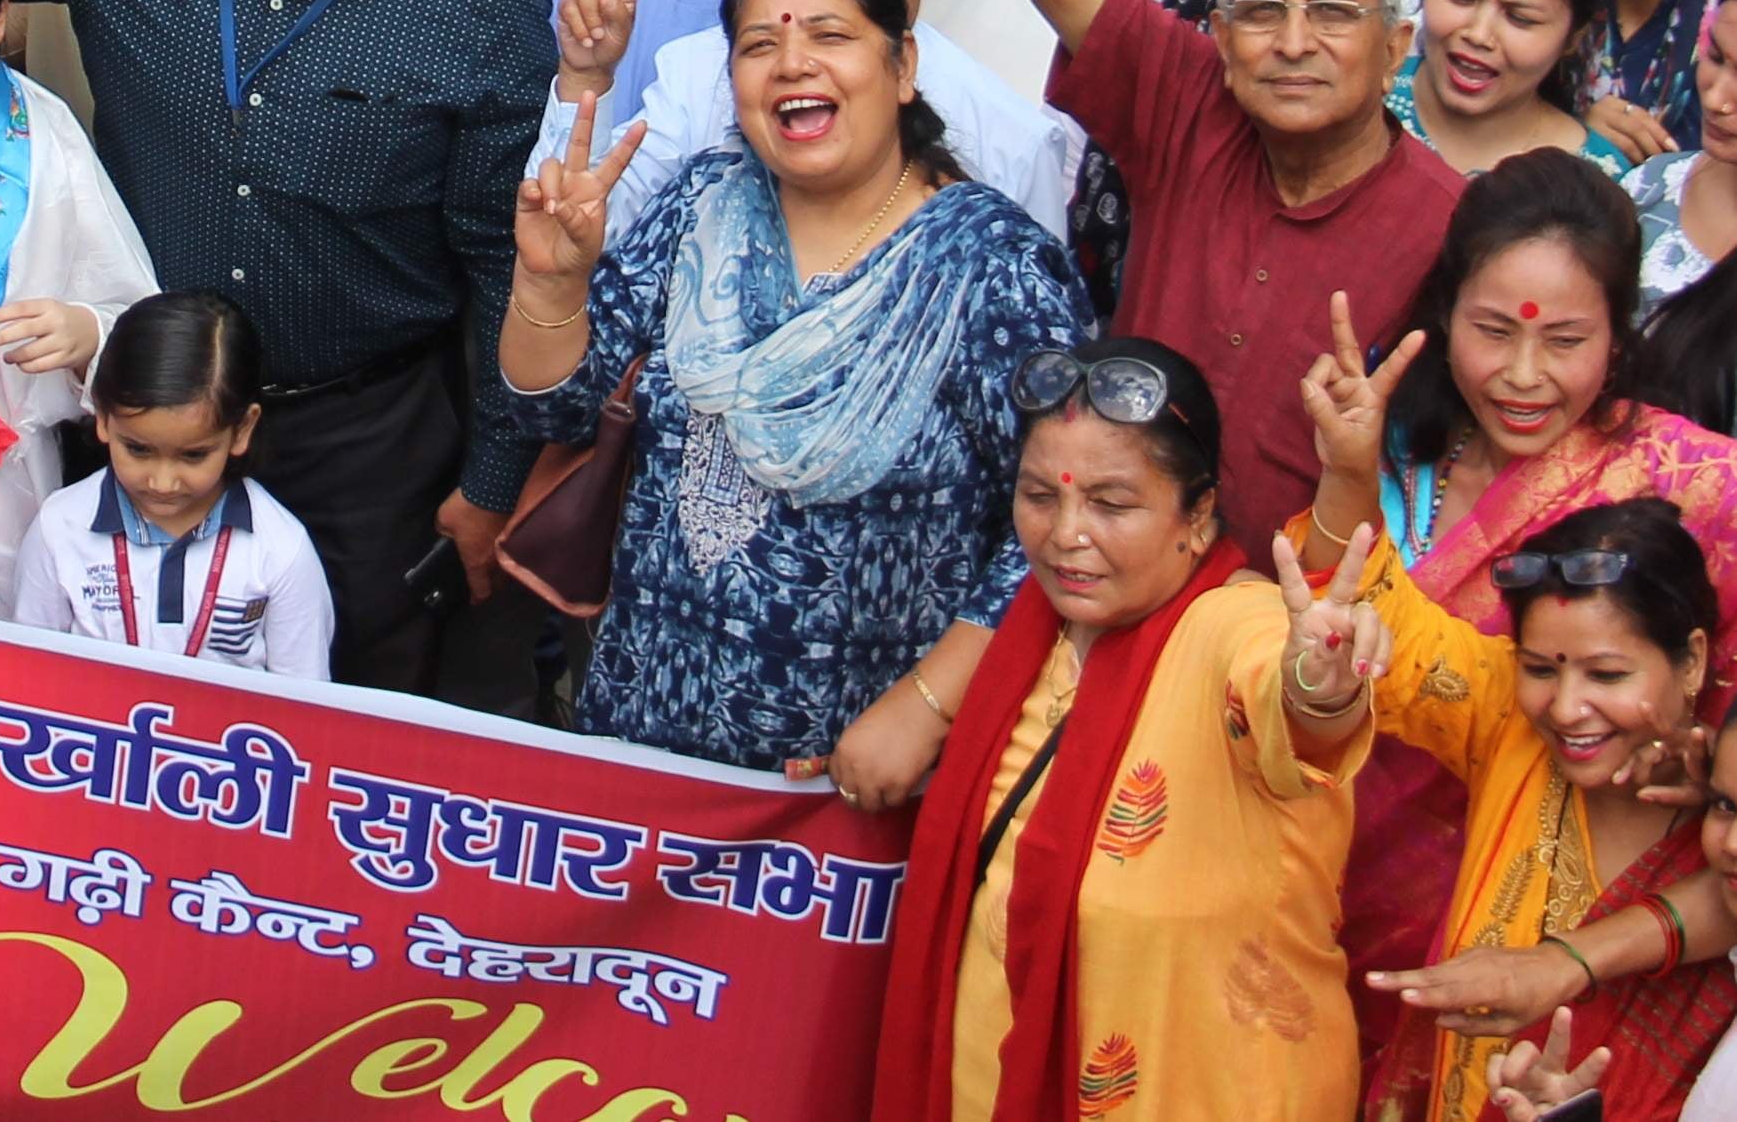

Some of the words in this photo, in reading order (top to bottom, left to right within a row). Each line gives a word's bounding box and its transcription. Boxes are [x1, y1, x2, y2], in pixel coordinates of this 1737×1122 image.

[327, 767, 648, 900] सुधार
[656, 829, 908, 944] सभा
[169, 870, 375, 969] कैन्ट,
[406, 914, 727, 1025] देहरादून
